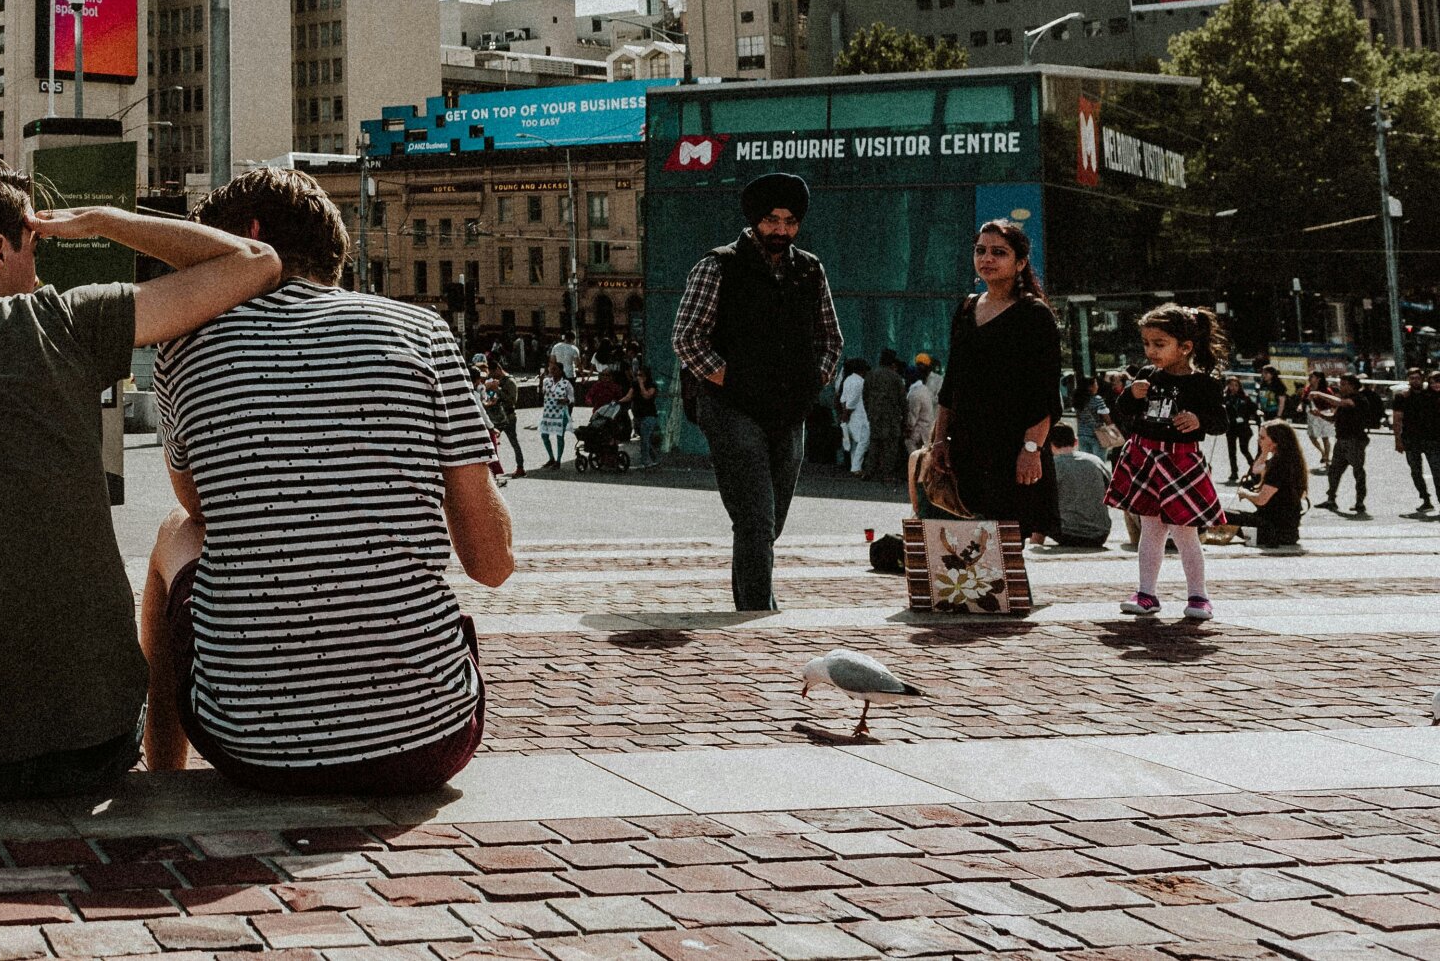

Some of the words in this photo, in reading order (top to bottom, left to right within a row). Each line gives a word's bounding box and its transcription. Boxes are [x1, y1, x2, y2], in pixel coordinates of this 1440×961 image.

[445, 109, 467, 122] GET
[471, 108, 489, 120] ON
[492, 106, 517, 119] TOP
[520, 104, 538, 117] OF
[540, 101, 576, 115] YOUR
[580, 95, 646, 112] BUSINESS
[521, 119, 538, 128] TOO
[540, 117, 560, 127] EASY
[736, 137, 845, 161] MELBOURNE
[854, 134, 931, 158] VISITOR
[940, 131, 1021, 155] CENTRE
[365, 160, 381, 168] APN
